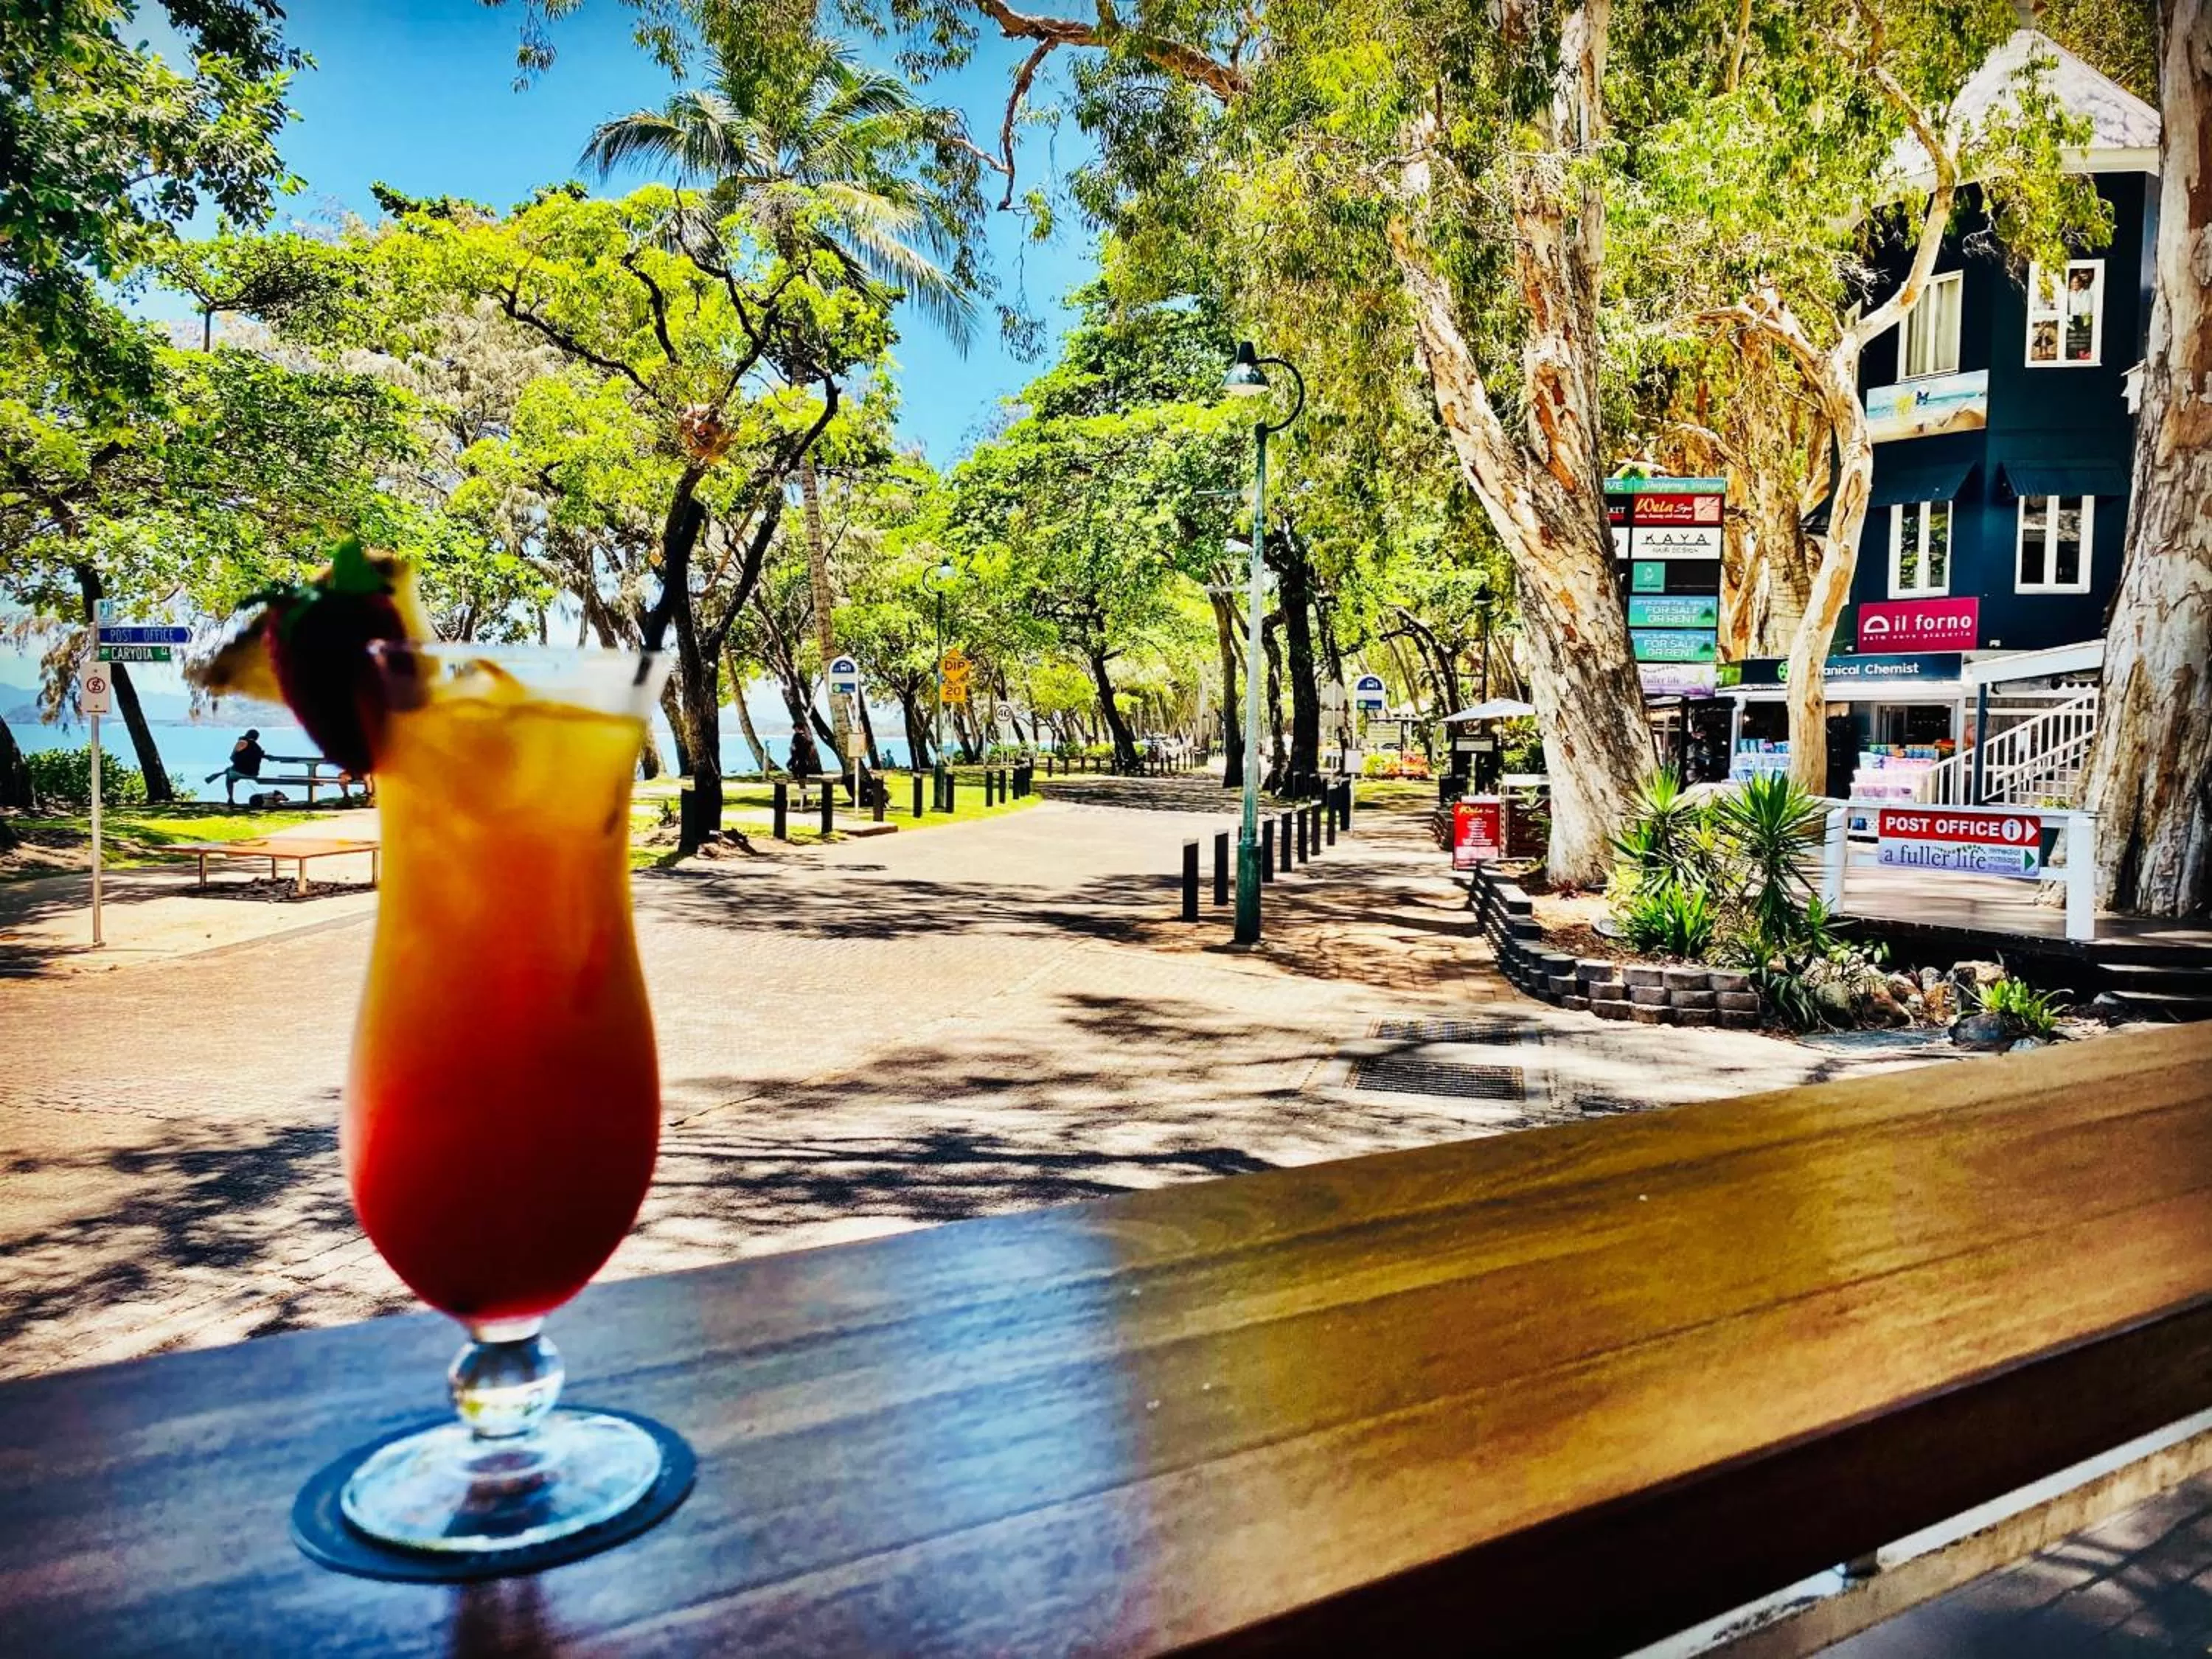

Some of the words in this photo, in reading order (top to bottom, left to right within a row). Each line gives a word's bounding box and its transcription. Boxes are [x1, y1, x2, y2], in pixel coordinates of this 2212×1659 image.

[1604, 482, 1624, 490] VE
[1646, 533, 1707, 545] KAYA
[1646, 606, 1668, 614] FOR
[1670, 606, 1699, 614] SALE
[1649, 615, 1665, 623] OR
[1666, 615, 1696, 623] RENT
[1894, 615, 1907, 632] il
[1915, 613, 1972, 630] forno
[111, 629, 132, 641] POST
[143, 629, 174, 641] OFFICE
[1644, 639, 1668, 647] FOR
[1670, 639, 1697, 647] SALE
[111, 647, 153, 660] CARYOTA
[1647, 649, 1663, 657] OR
[1665, 649, 1694, 657] RENT
[945, 660, 965, 670] DIP
[1823, 664, 1860, 675] anical
[1865, 662, 1920, 675] Chemist
[946, 686, 961, 695] 20
[1885, 816, 1930, 832] POST
[1935, 819, 2000, 837] OFFICE
[1884, 849, 1893, 862] a
[1901, 845, 1950, 867] fuller
[1957, 849, 1986, 869] life
